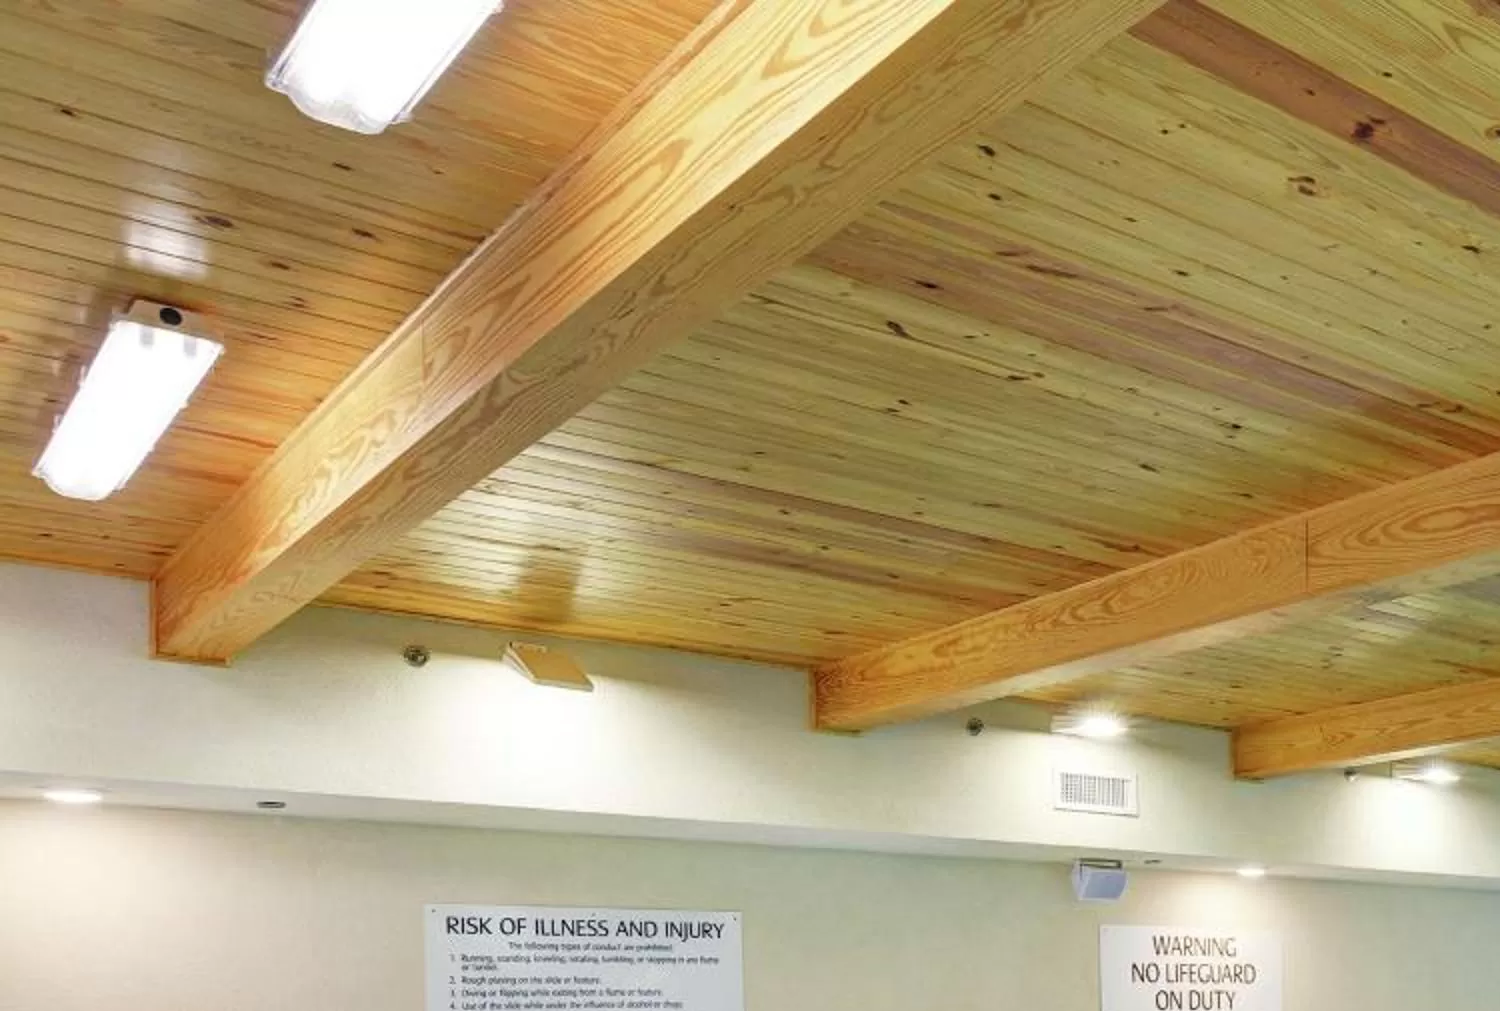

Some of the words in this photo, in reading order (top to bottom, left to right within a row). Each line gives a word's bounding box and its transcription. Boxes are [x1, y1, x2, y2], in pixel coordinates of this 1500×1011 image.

[446, 916, 493, 935] RISK
[499, 917, 527, 935] OF
[535, 918, 609, 937] ILLNESS
[616, 920, 658, 938] AND
[664, 921, 725, 942] INJURY
[1152, 935, 1237, 957] WARNING
[1131, 963, 1160, 983] NO
[1165, 964, 1257, 985] LIFEGUARD
[1155, 990, 1182, 1010] ON
[1188, 990, 1237, 1010] DUTY
